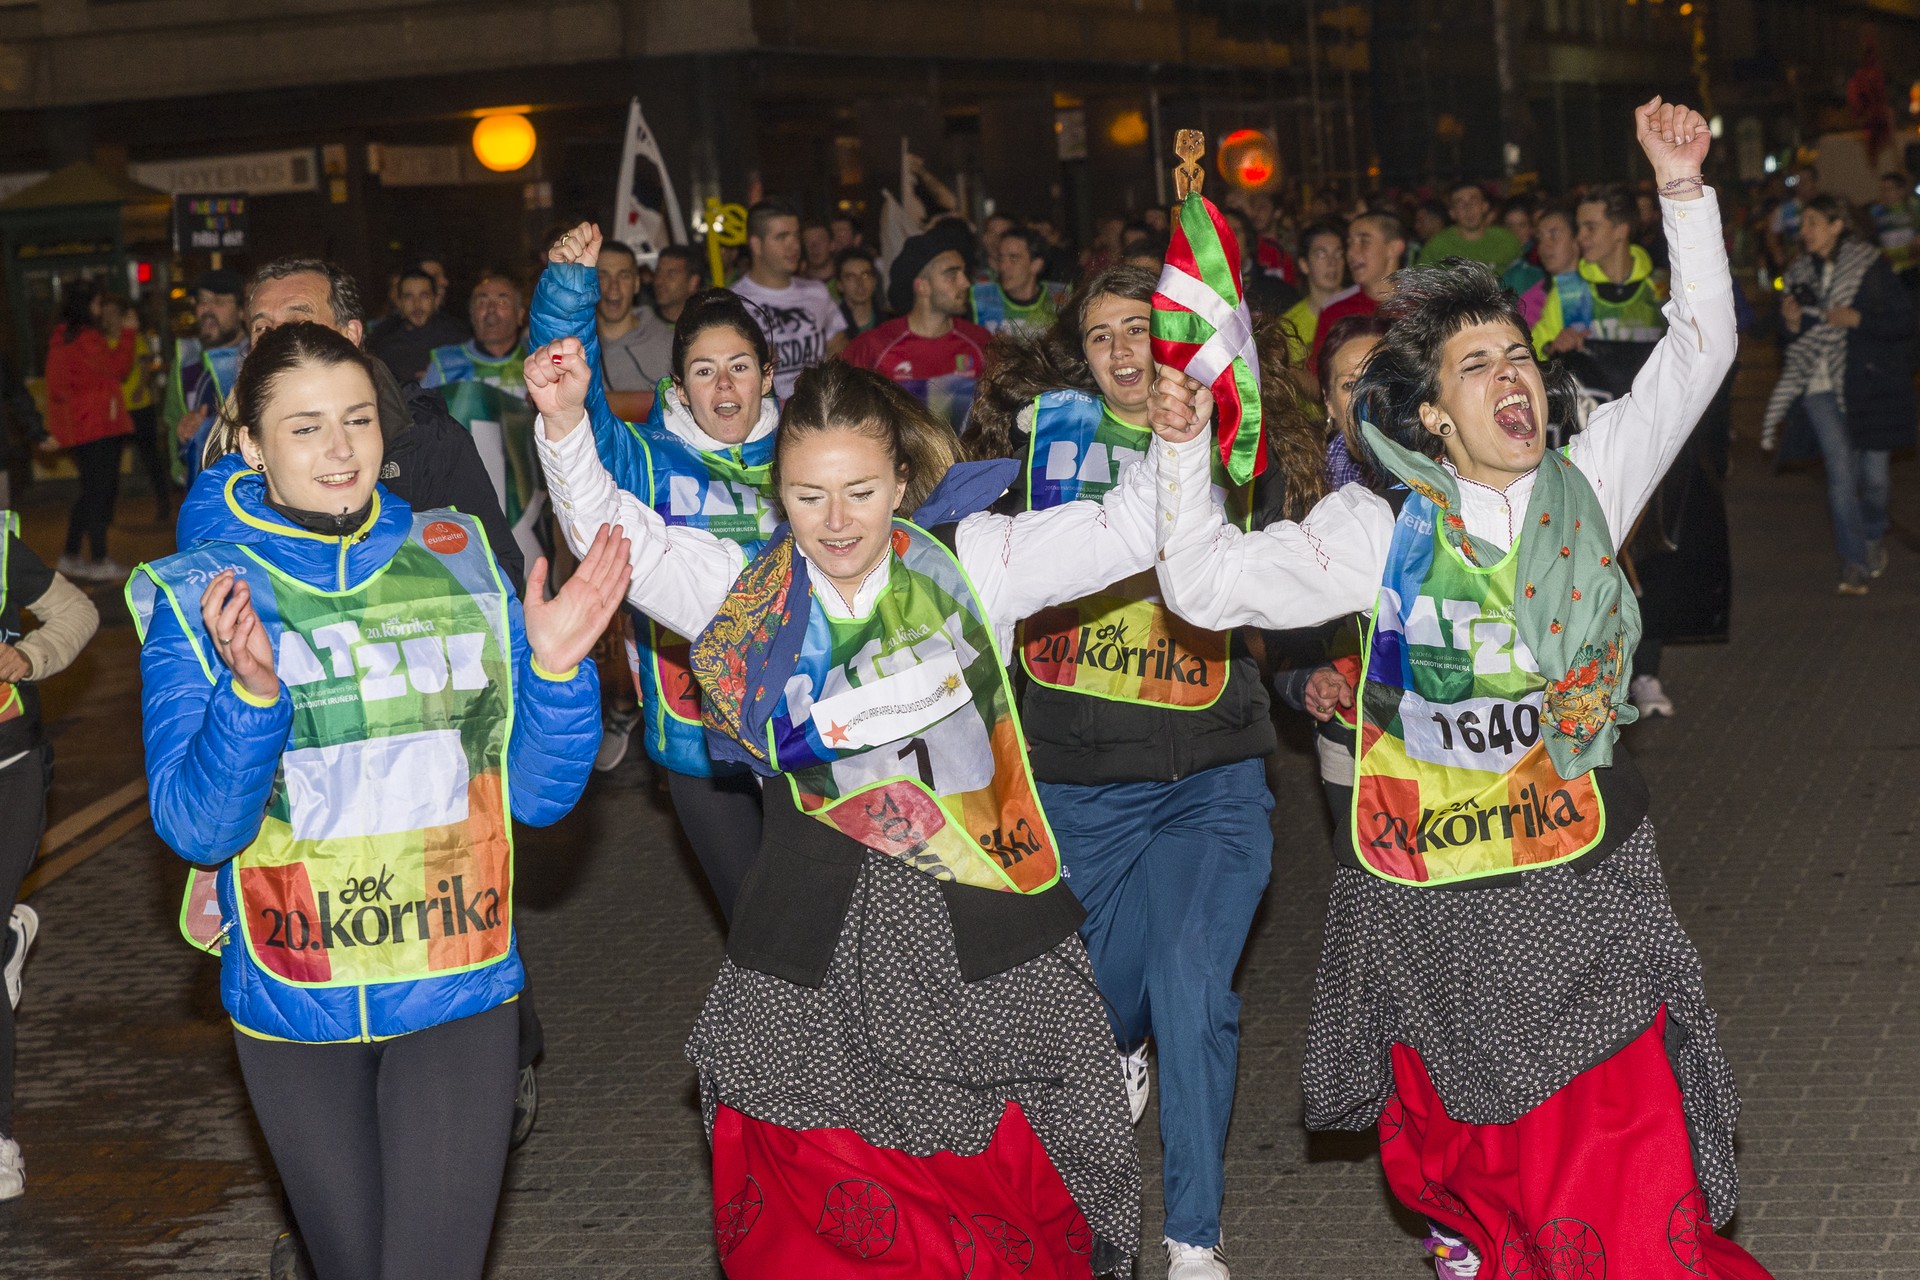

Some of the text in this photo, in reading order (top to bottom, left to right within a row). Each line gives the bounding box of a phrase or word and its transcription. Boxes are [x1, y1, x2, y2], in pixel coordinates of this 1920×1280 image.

[428, 531, 465, 545] euskaltel
[277, 620, 361, 687] AT
[1431, 703, 1540, 756] 1640
[898, 737, 935, 792] 1
[339, 863, 394, 904] aek
